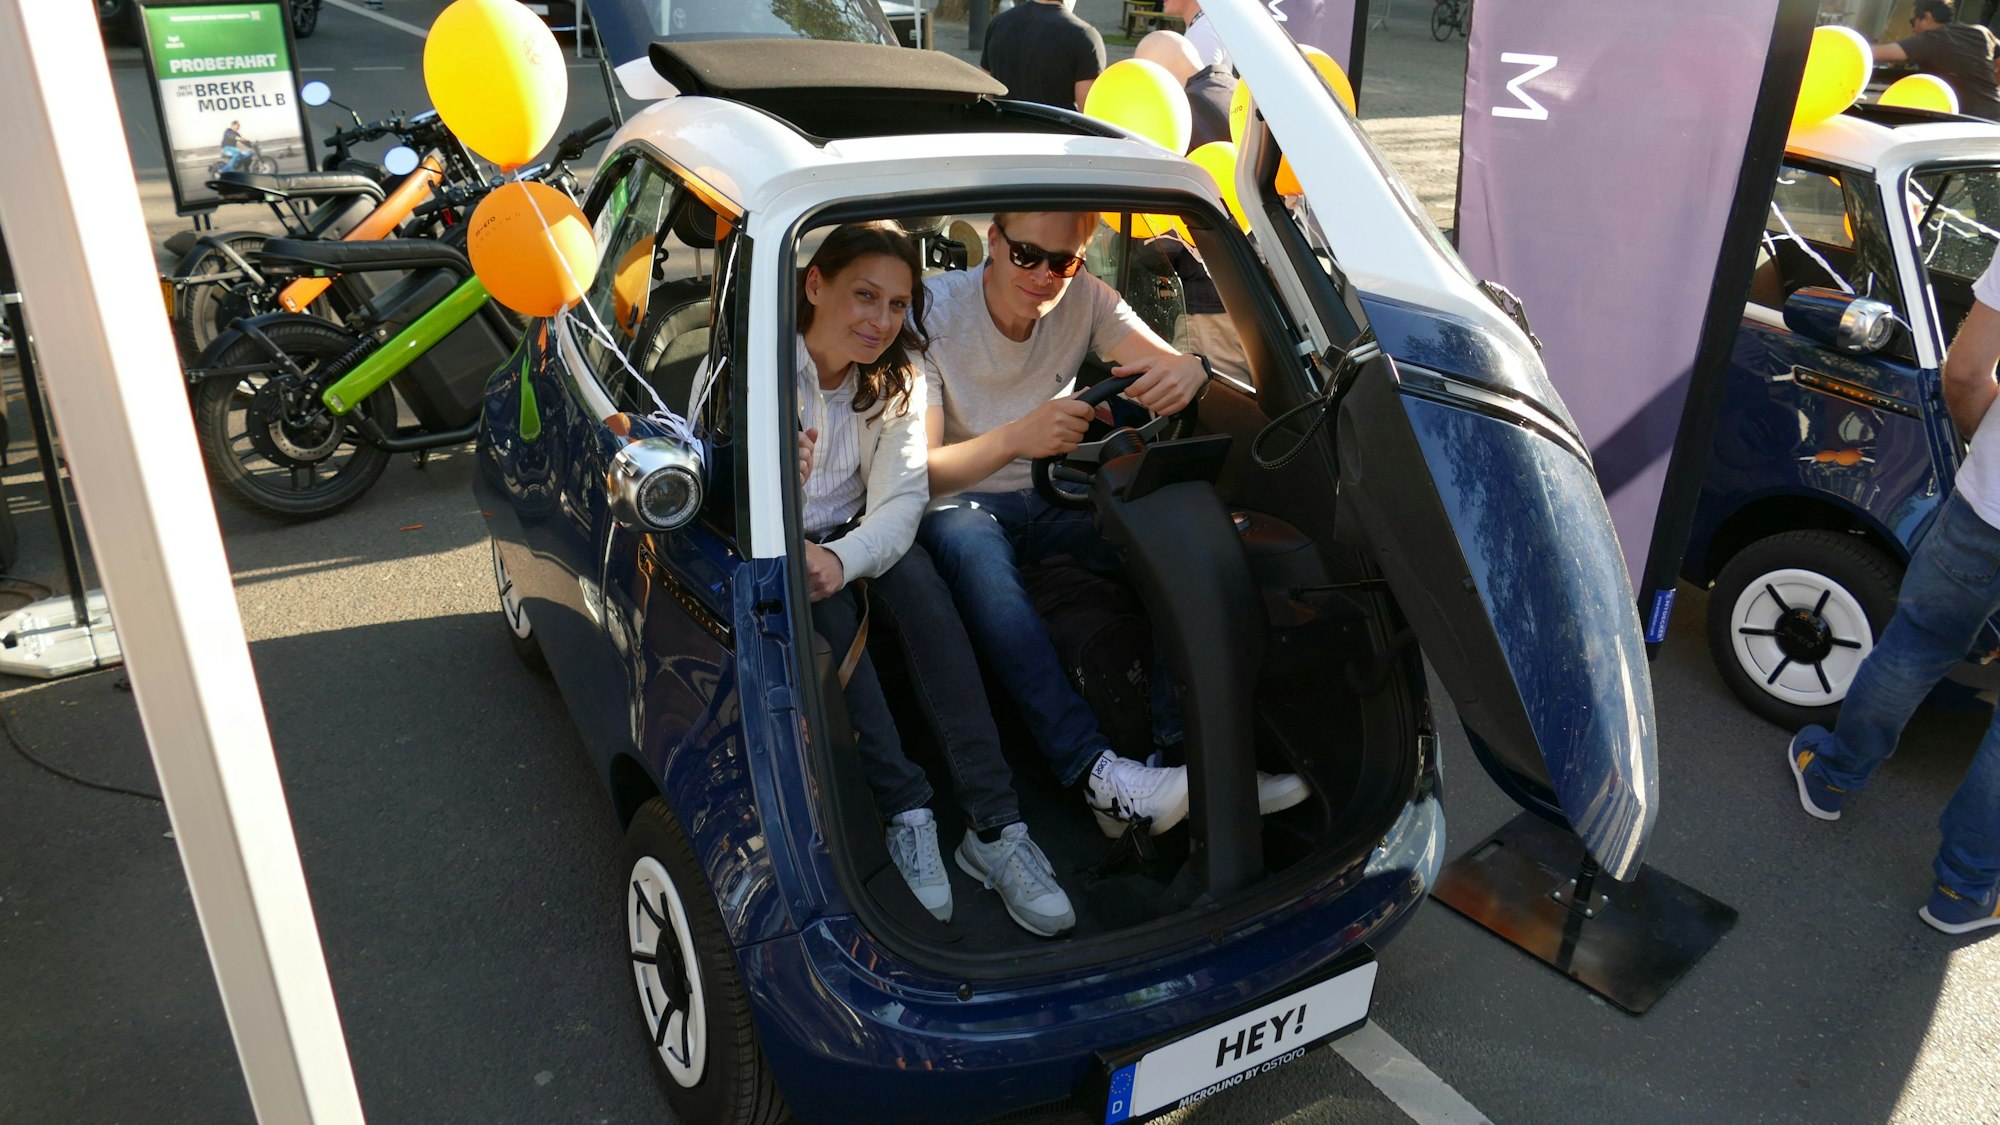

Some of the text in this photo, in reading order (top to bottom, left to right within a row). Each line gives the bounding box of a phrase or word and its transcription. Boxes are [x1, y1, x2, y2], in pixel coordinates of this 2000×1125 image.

[169, 53, 277, 73] PROBEFAHRT
[195, 80, 255, 97] BREKR
[1492, 53, 1558, 121] M
[198, 93, 286, 112] MODELL B
[1215, 1004, 1307, 1068] HEY!
[1178, 1074, 1244, 1109] MICROLINO
[1245, 1067, 1261, 1080] BY
[1112, 1100, 1123, 1115] D
